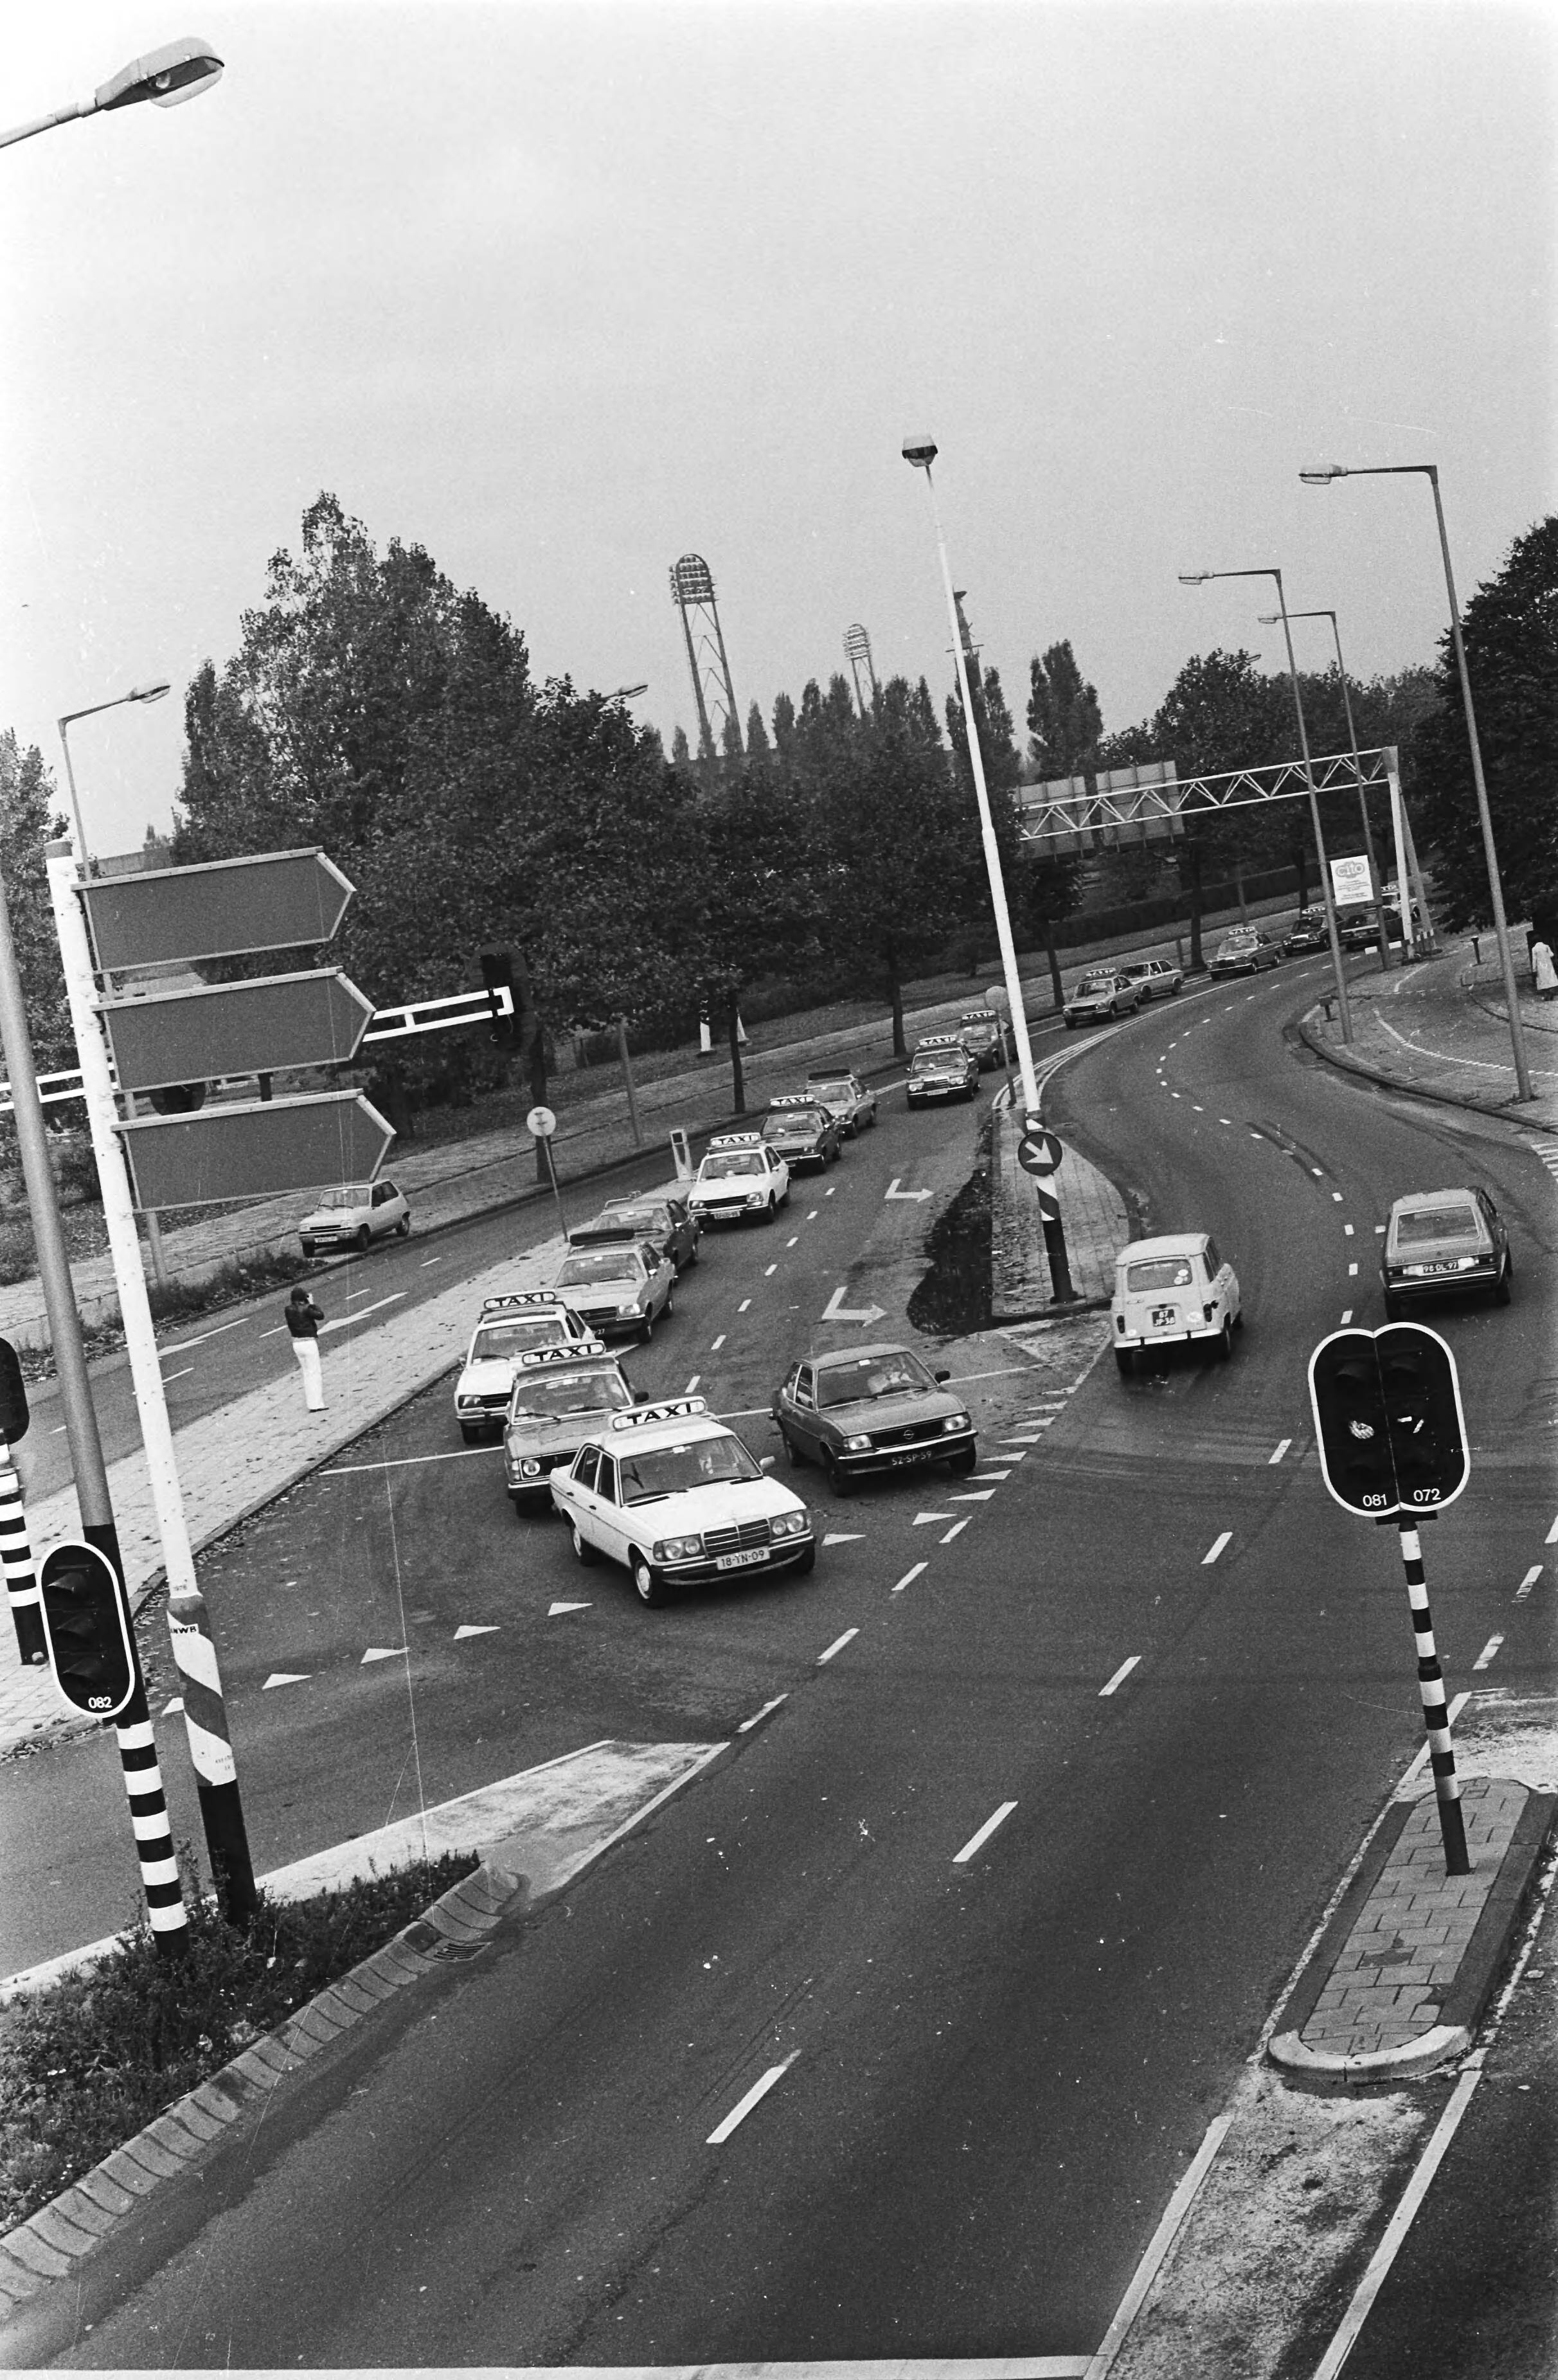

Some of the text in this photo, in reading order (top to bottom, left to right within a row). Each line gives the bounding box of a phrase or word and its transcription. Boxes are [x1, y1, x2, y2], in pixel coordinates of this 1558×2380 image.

[925, 1037, 951, 1045] TAXI
[777, 1096, 807, 1105] TAXI
[719, 1135, 751, 1144] TAXI
[494, 1292, 544, 1307] TAXI
[533, 1345, 591, 1361] TAXI
[626, 1402, 692, 1424] TAXI
[1363, 1494, 1387, 1507] 081
[1413, 1488, 1441, 1502] 072
[88, 1696, 112, 1708] 082
